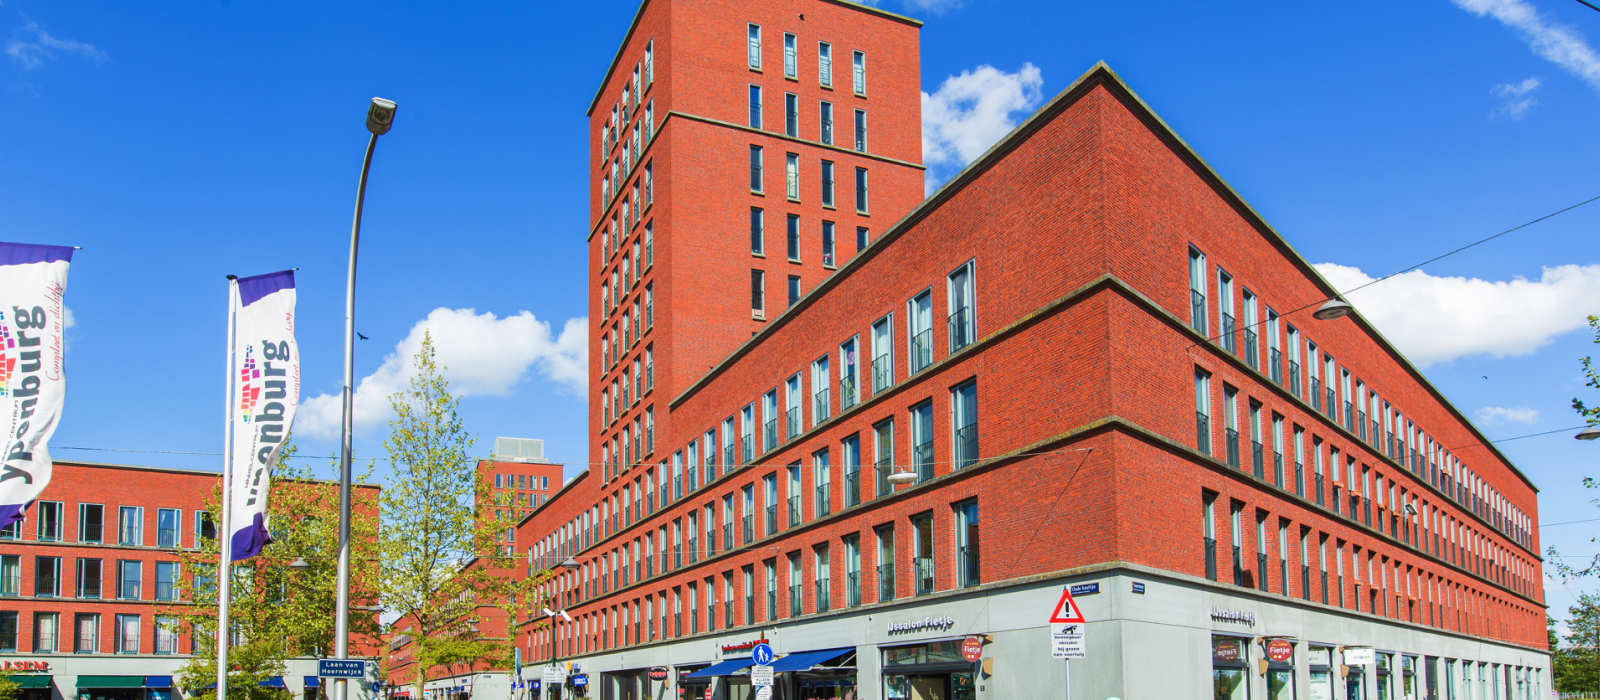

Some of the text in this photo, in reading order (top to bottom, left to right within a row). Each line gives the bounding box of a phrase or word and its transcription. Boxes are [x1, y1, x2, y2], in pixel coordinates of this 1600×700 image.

[44, 280, 64, 381] Compleet en dichtbij
[0, 305, 46, 485] ypenburg
[244, 424, 259, 489] WINKELCENTRUM
[887, 615, 953, 632] IJssalon Fietje
[964, 645, 981, 655] Fietje
[1269, 647, 1290, 655] Fietje
